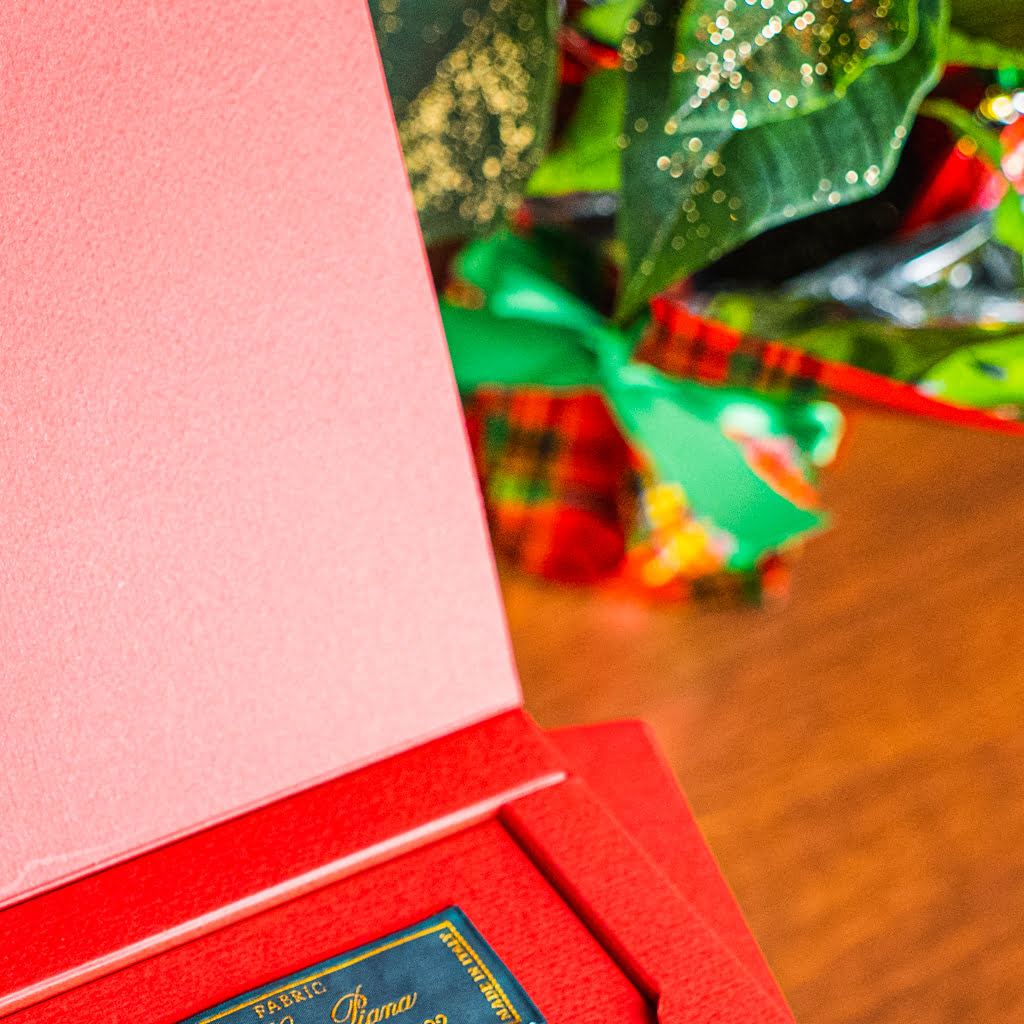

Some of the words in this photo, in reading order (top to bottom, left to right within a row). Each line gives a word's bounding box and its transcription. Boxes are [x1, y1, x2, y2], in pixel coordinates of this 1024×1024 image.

[439, 933, 473, 966] ITALY
[467, 966, 485, 982] IN
[254, 981, 327, 1018] FABRIC
[479, 981, 511, 1020] MADE
